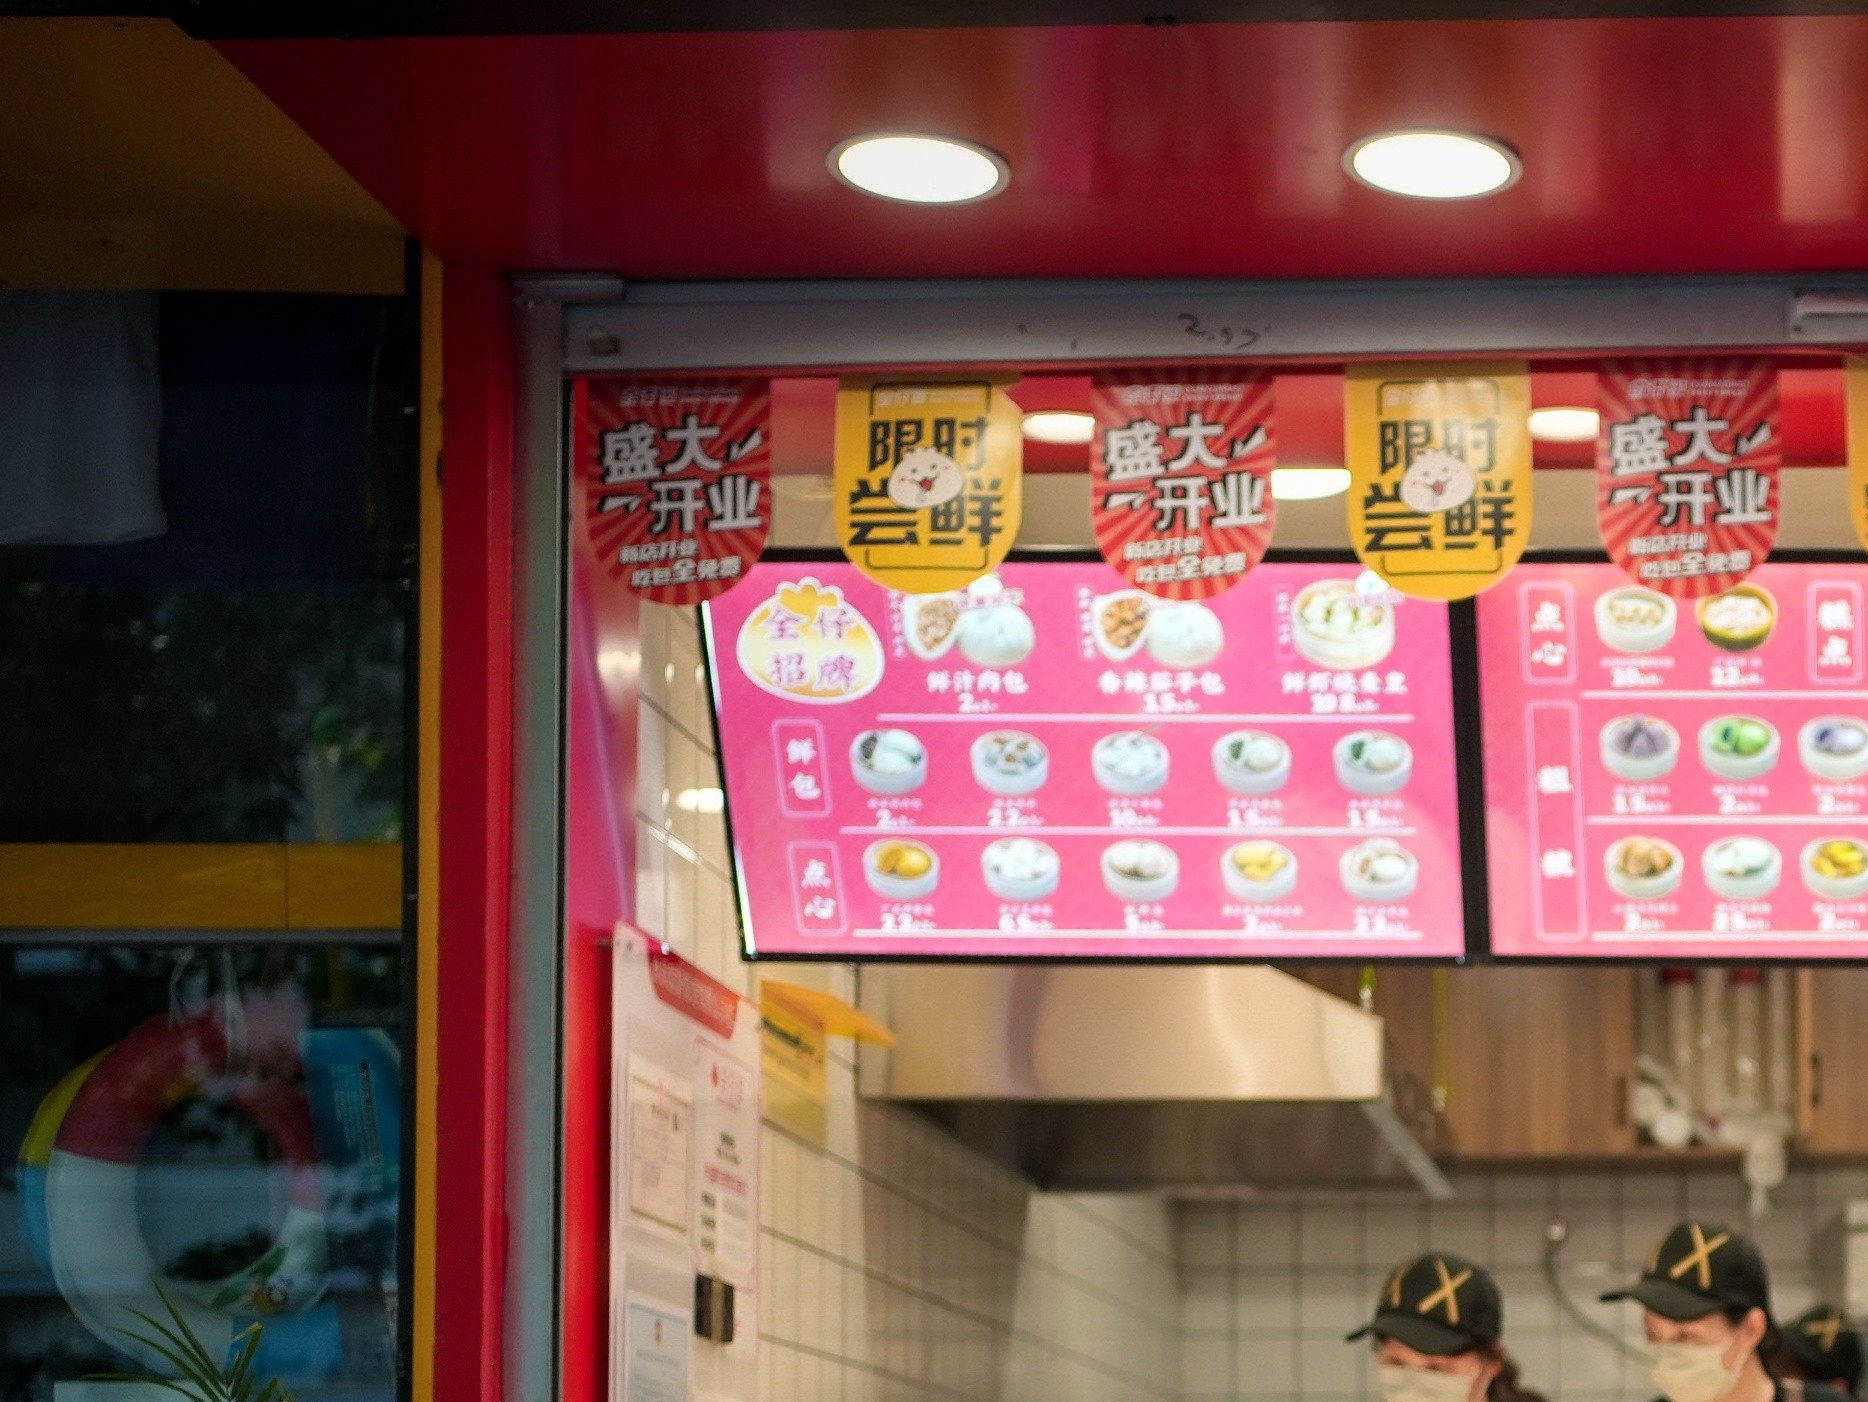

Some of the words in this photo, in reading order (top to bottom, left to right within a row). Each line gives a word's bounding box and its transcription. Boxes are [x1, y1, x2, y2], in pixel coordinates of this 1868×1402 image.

[602, 415, 722, 485] 盛大
[869, 418, 989, 472] 限时
[1106, 411, 1226, 481] 盛大
[1377, 418, 1497, 475] 限时
[1611, 407, 1731, 475] 盛大
[649, 474, 763, 535] 开业
[850, 477, 1003, 547] 尝鲜
[1156, 472, 1267, 532] 开业
[1364, 480, 1516, 554] 尝鲜
[1660, 468, 1772, 527] 开业
[761, 606, 855, 641] 全仔
[769, 653, 855, 692] 招牌
